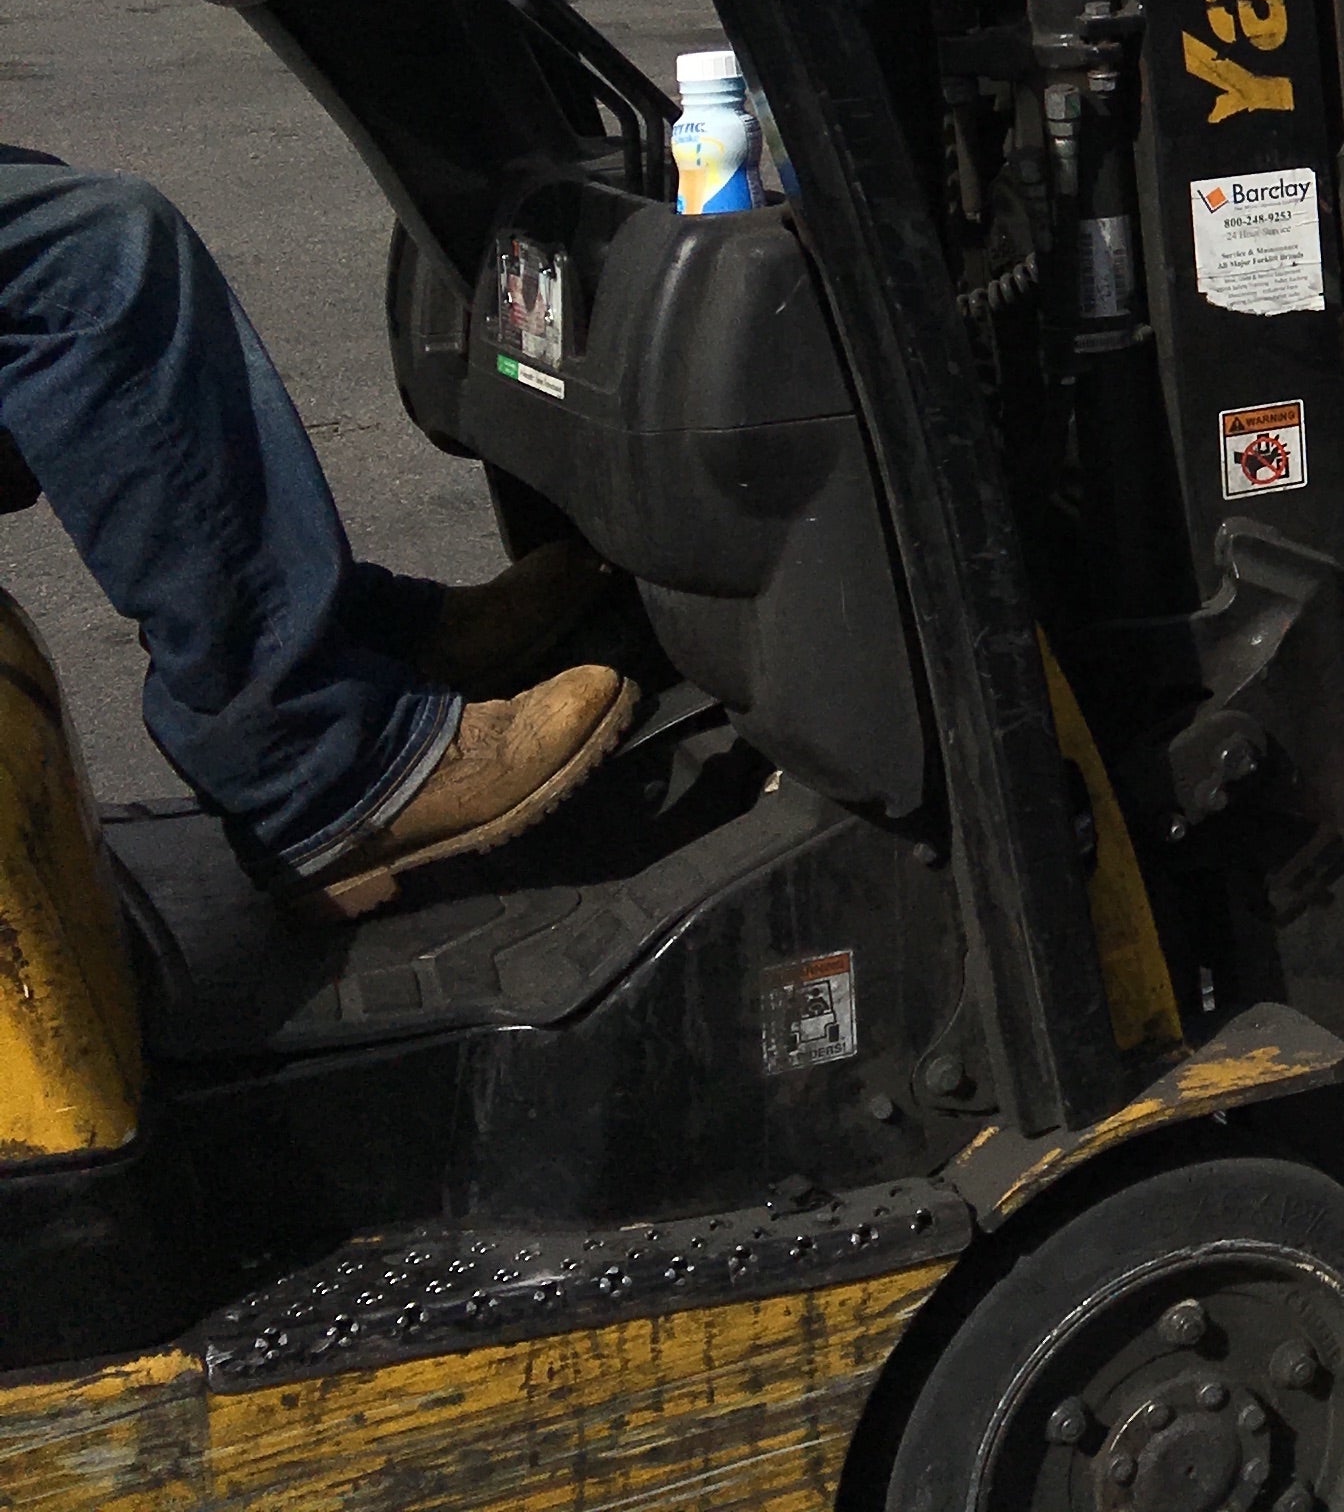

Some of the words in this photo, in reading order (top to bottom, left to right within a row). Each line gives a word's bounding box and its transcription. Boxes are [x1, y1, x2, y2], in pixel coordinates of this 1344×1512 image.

[1232, 178, 1311, 204] Barclay
[1223, 211, 1292, 229] 800-248-9253
[1245, 410, 1296, 427] WARNING
